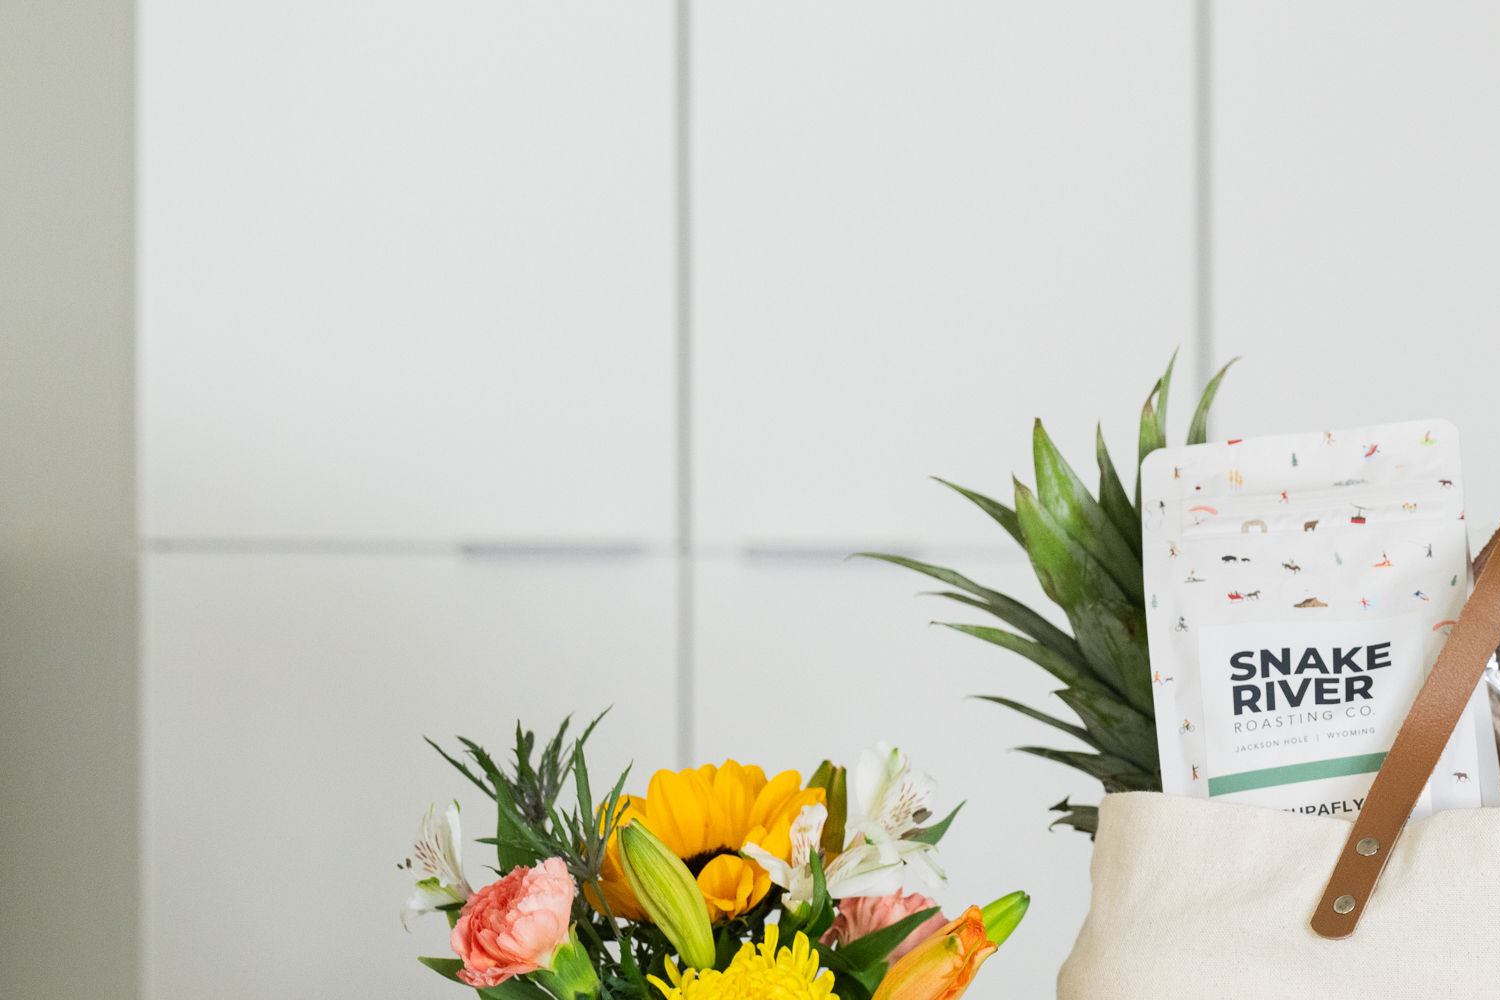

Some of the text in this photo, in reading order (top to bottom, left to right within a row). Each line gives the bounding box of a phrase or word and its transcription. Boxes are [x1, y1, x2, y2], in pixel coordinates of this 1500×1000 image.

[1230, 641, 1392, 681] SNAKE
[1232, 675, 1374, 715] RIVER
[1234, 705, 1375, 733] ROASTING CO.
[1235, 727, 1376, 752] JACKSON HOLE WYOMING
[1282, 798, 1364, 816] PAFLY
